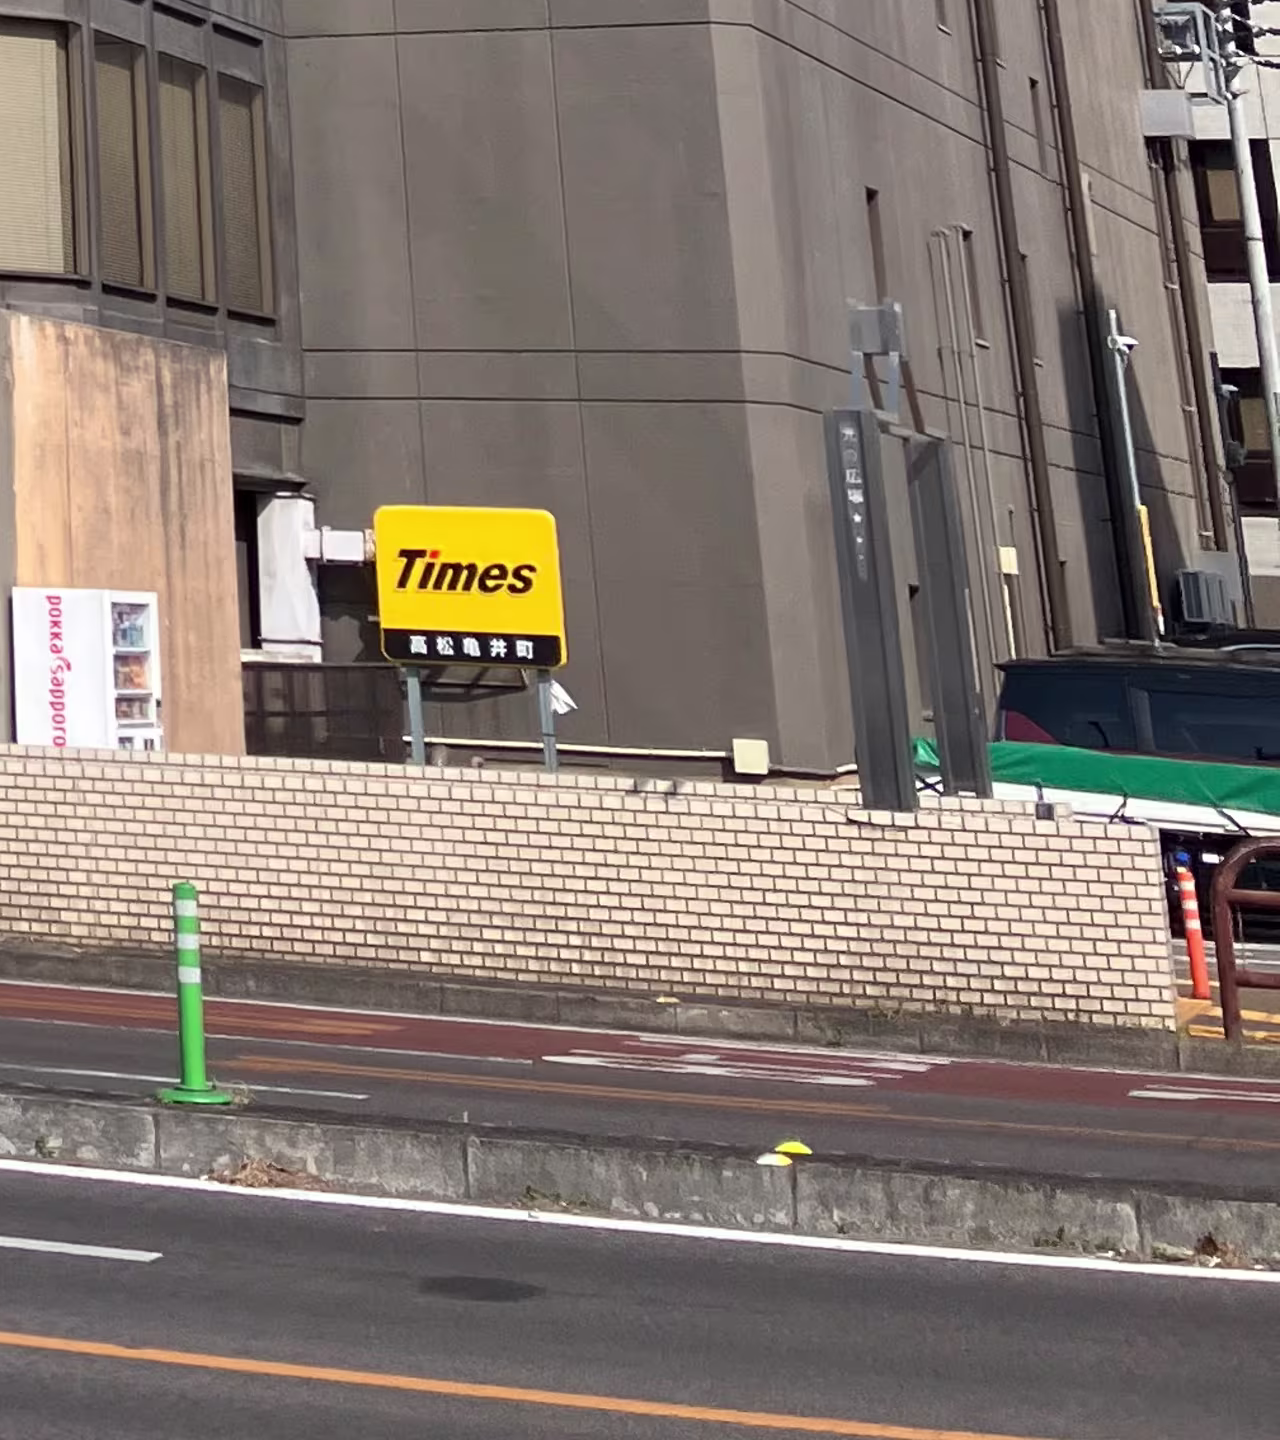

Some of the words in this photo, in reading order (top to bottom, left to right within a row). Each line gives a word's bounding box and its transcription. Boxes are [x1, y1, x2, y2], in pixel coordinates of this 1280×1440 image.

[396, 549, 537, 594] Times
[409, 635, 534, 659] 高松亀井町
